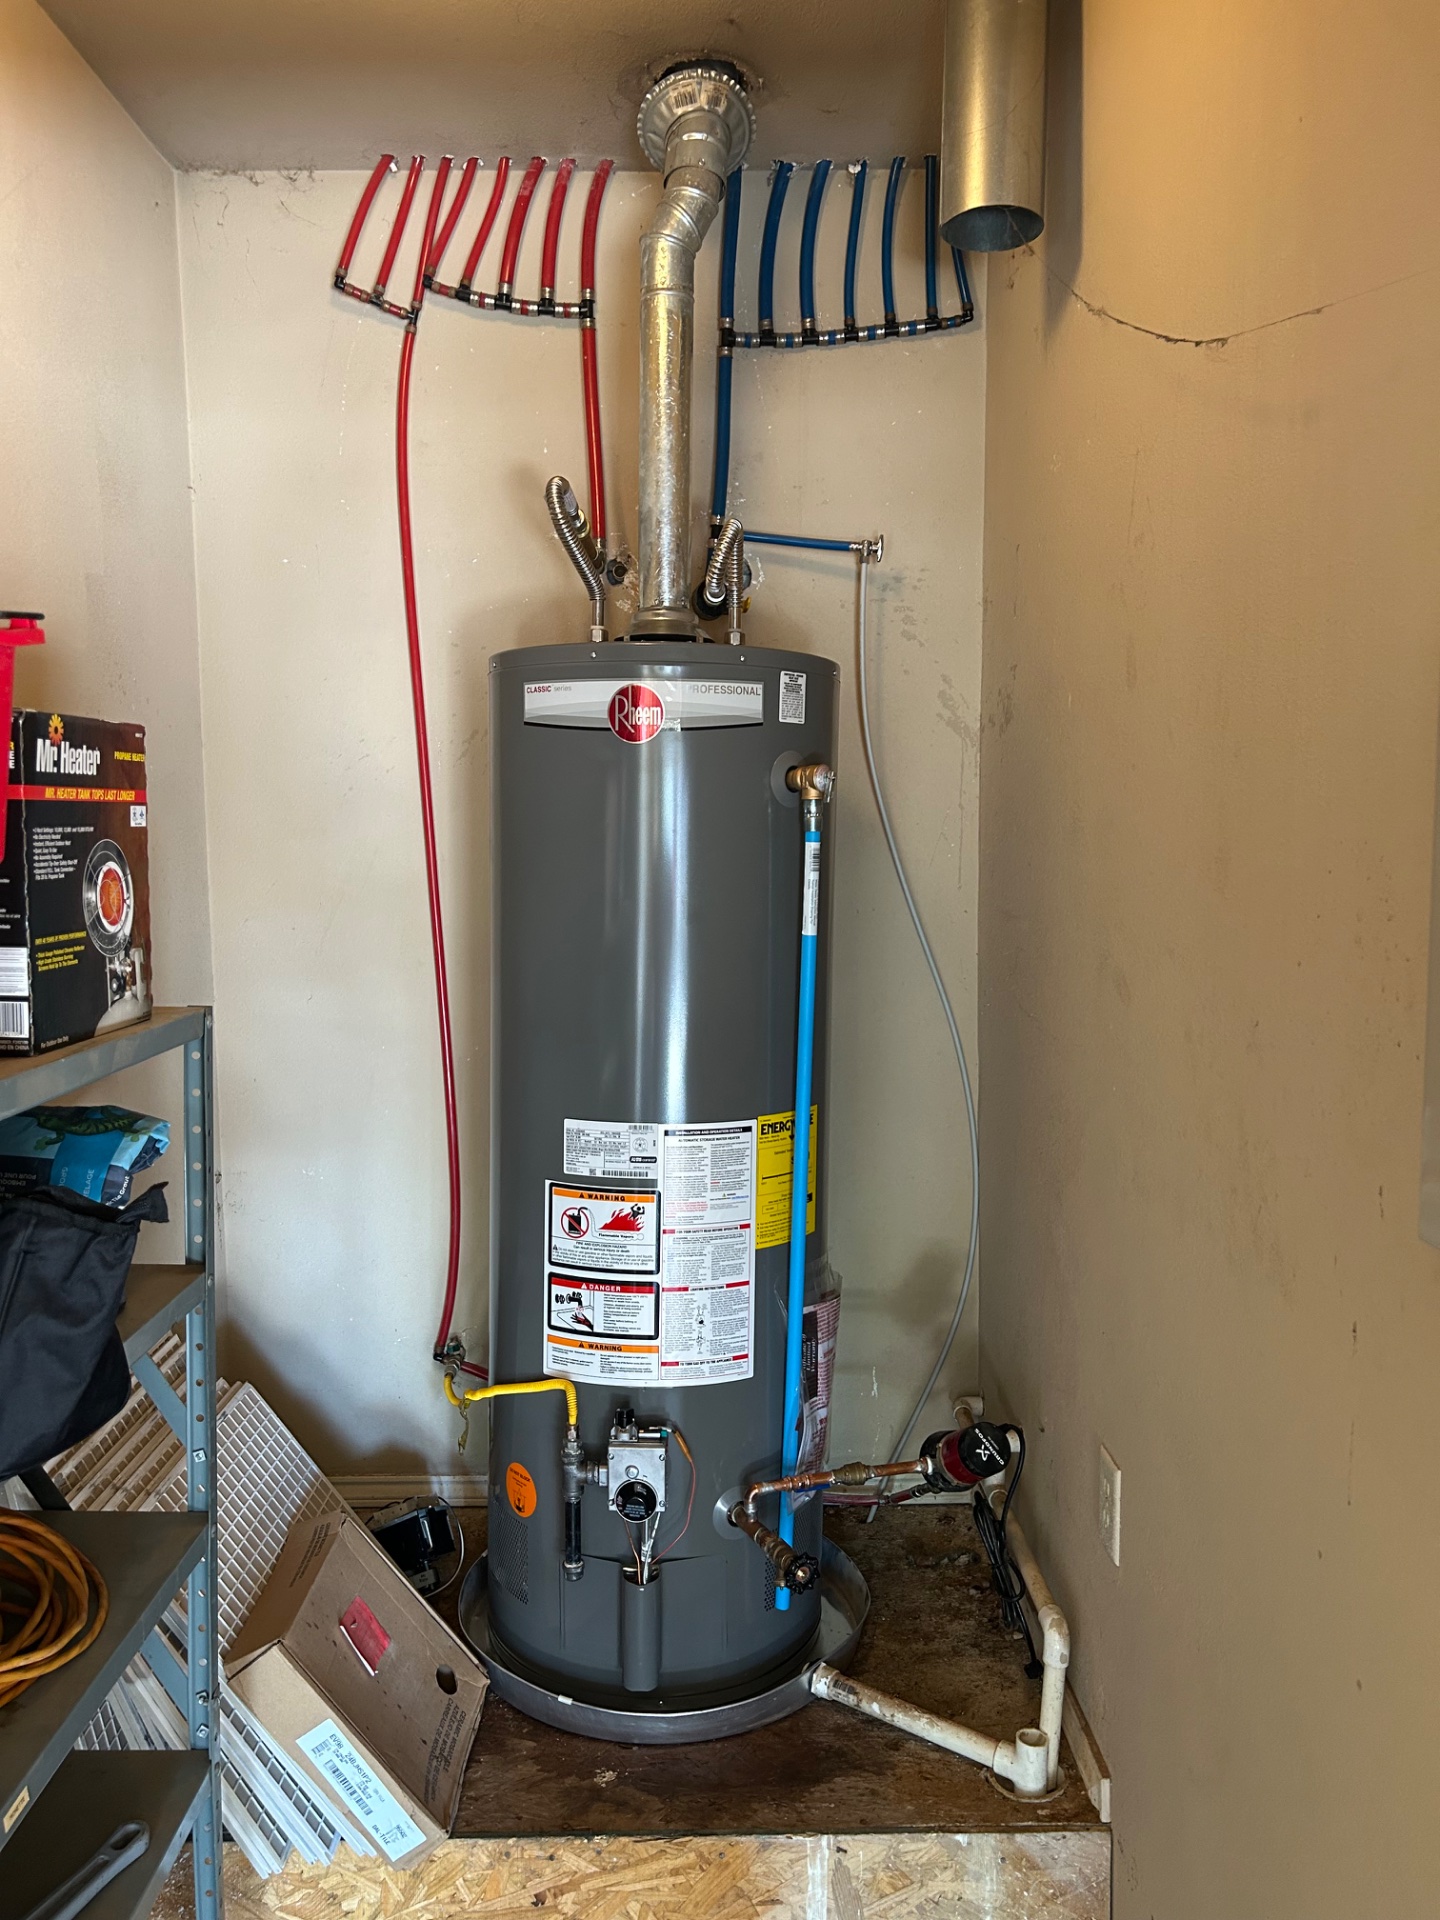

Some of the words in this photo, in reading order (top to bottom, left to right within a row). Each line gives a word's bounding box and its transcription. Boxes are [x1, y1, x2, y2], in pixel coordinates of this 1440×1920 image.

[526, 685, 552, 693] CLASSIC
[615, 684, 662, 733] Rheem
[36, 738, 58, 773] Mr.
[60, 741, 100, 776] Heater
[114, 751, 131, 761] PROPANE
[132, 753, 145, 762] HEATER
[45, 788, 55, 798] MR.
[56, 788, 77, 799] HEATER
[78, 789, 91, 800] TANK
[92, 790, 104, 800] TOPS
[104, 790, 116, 800] LAST
[117, 791, 135, 801] LONGER
[119, 1176, 130, 1199] Grout
[588, 1193, 626, 1202] WARNING
[975, 1428, 1004, 1465] GRUNDFOS
[453, 1710, 466, 1738] CERAMIC
